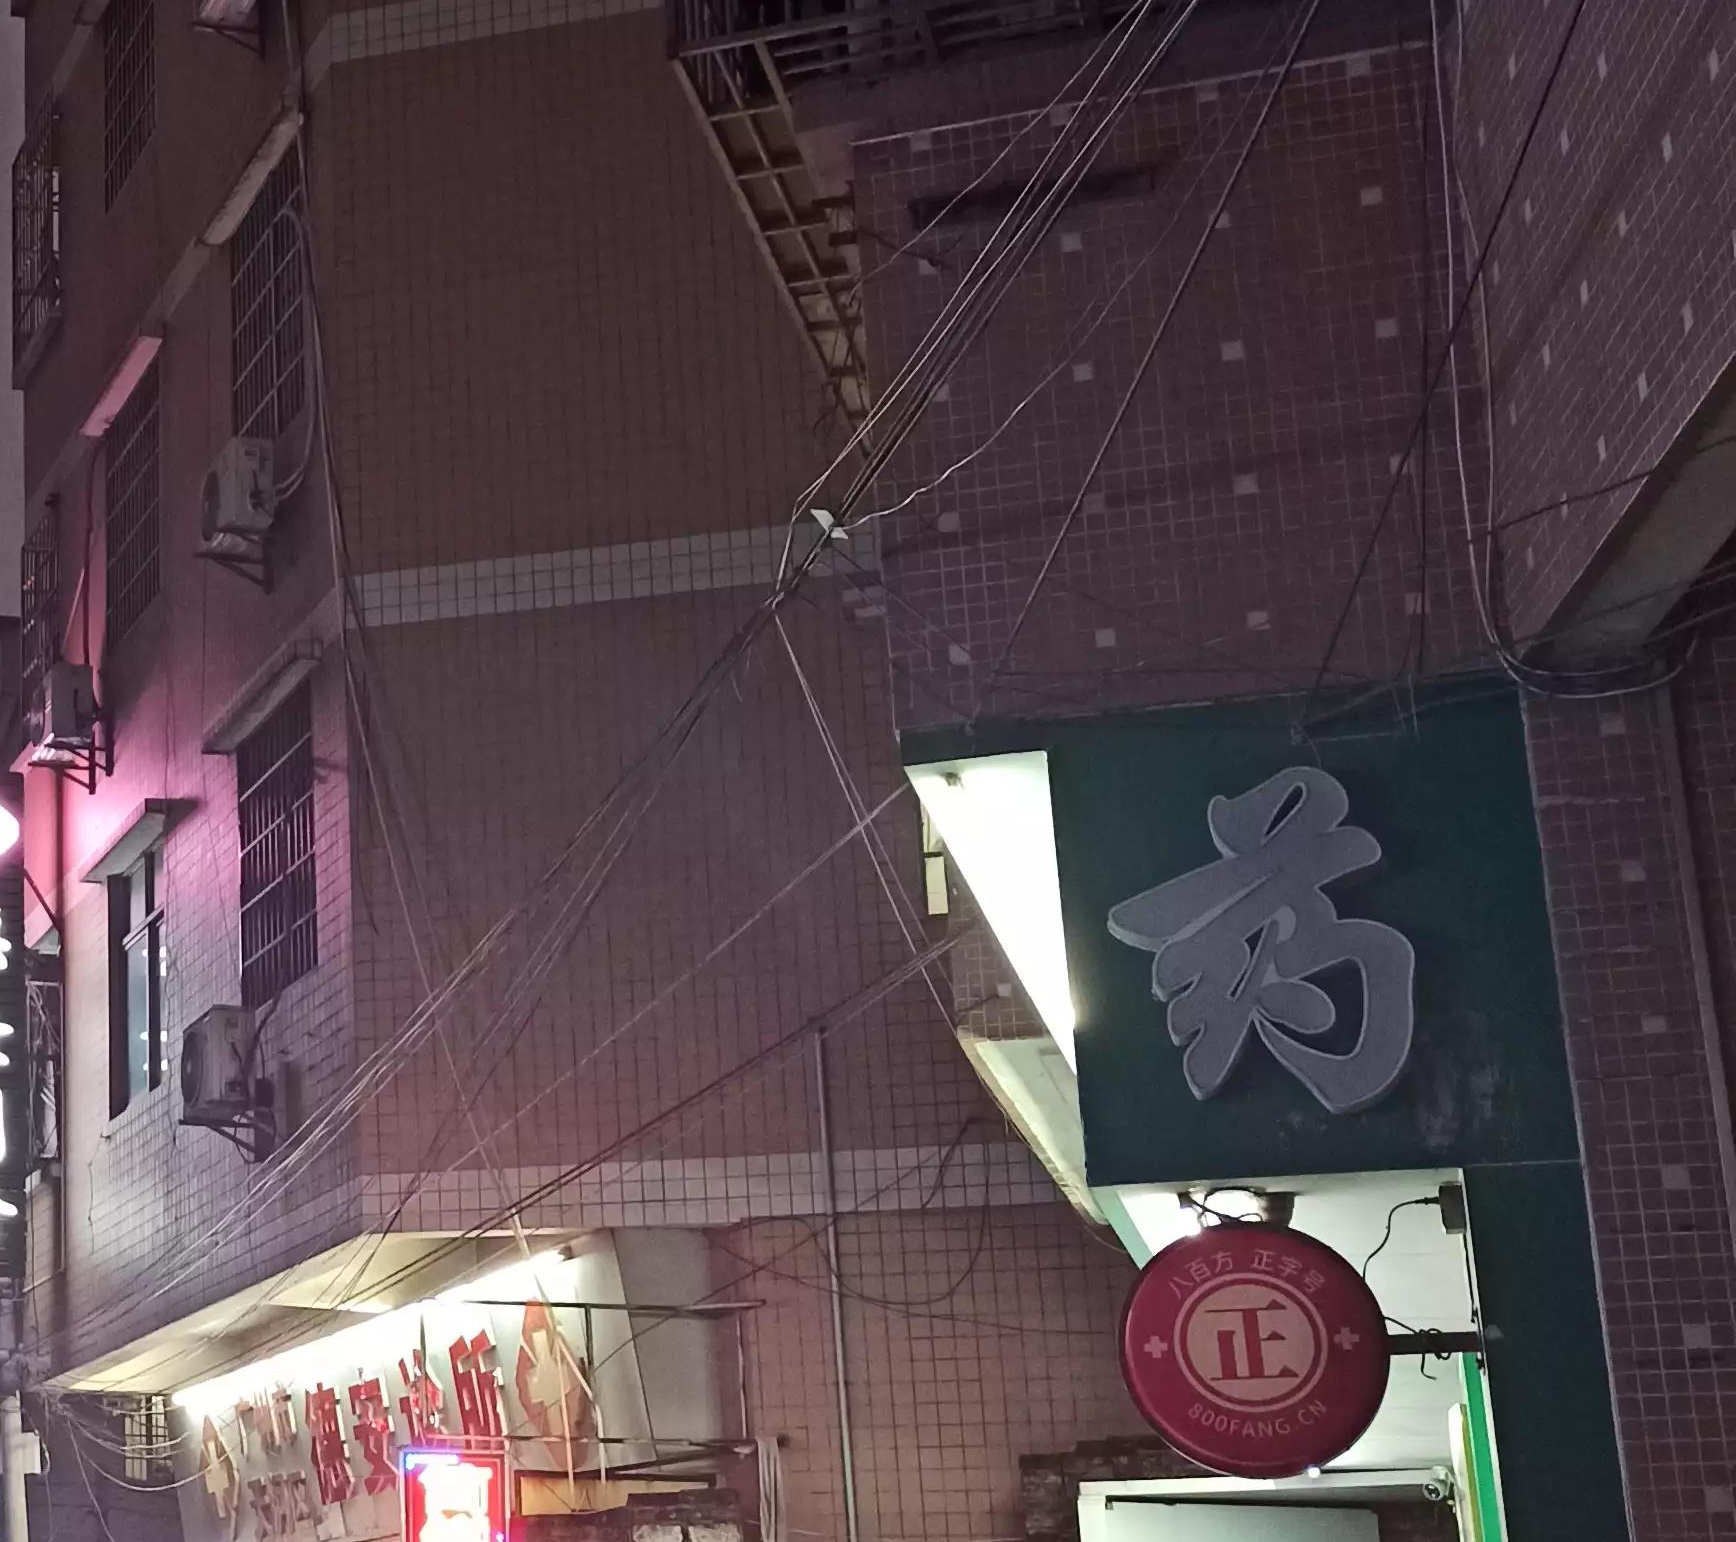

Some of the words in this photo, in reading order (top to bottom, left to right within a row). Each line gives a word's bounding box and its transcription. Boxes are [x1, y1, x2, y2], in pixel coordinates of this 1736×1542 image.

[1108, 765, 1416, 1115] 药
[1169, 1251, 1235, 1299] 八百方
[1250, 1248, 1326, 1293] 正字号
[1205, 1298, 1299, 1381] 正
[1187, 1399, 1327, 1438] 800FANG.CN
